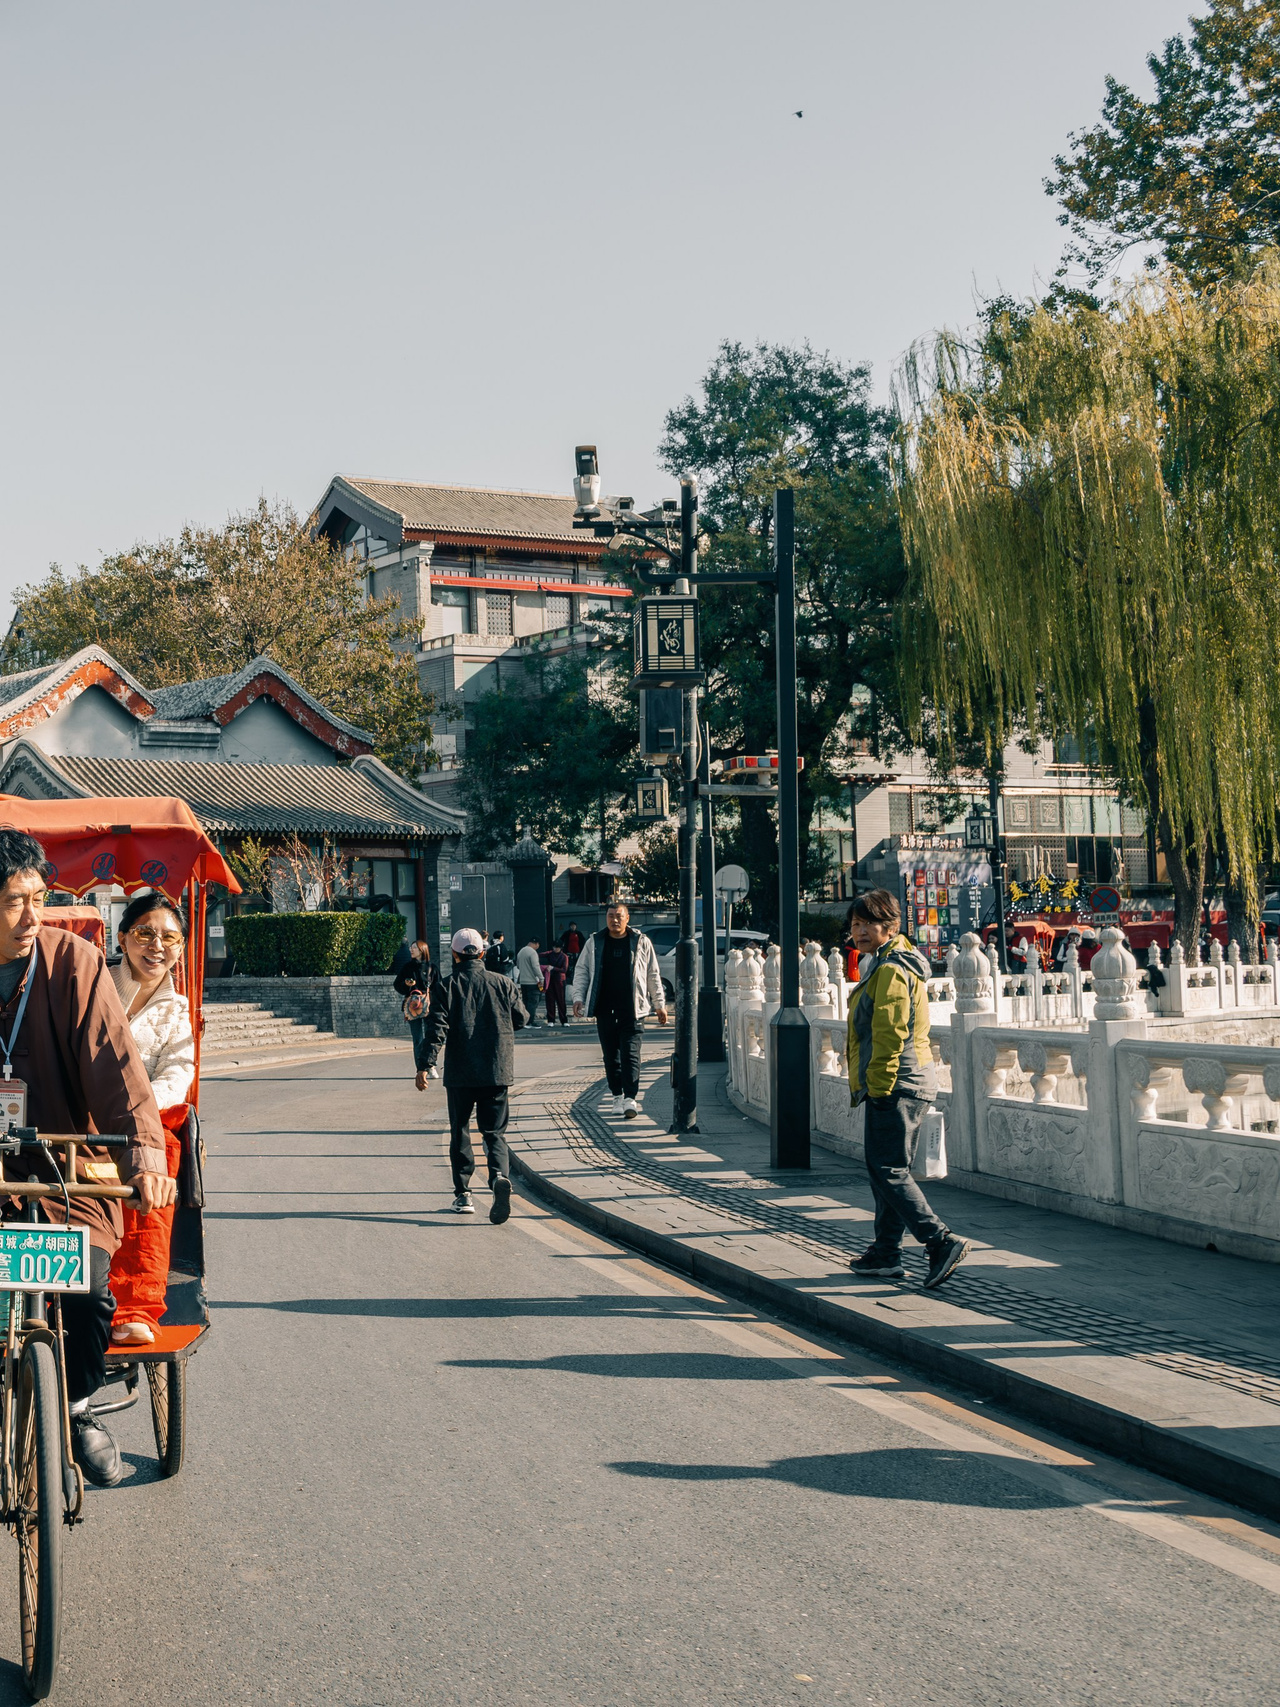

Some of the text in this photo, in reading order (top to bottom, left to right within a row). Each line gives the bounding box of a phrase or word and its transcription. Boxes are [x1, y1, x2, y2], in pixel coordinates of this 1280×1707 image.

[44, 1235, 80, 1253] 胡同游
[19, 1253, 81, 1284] 0022
